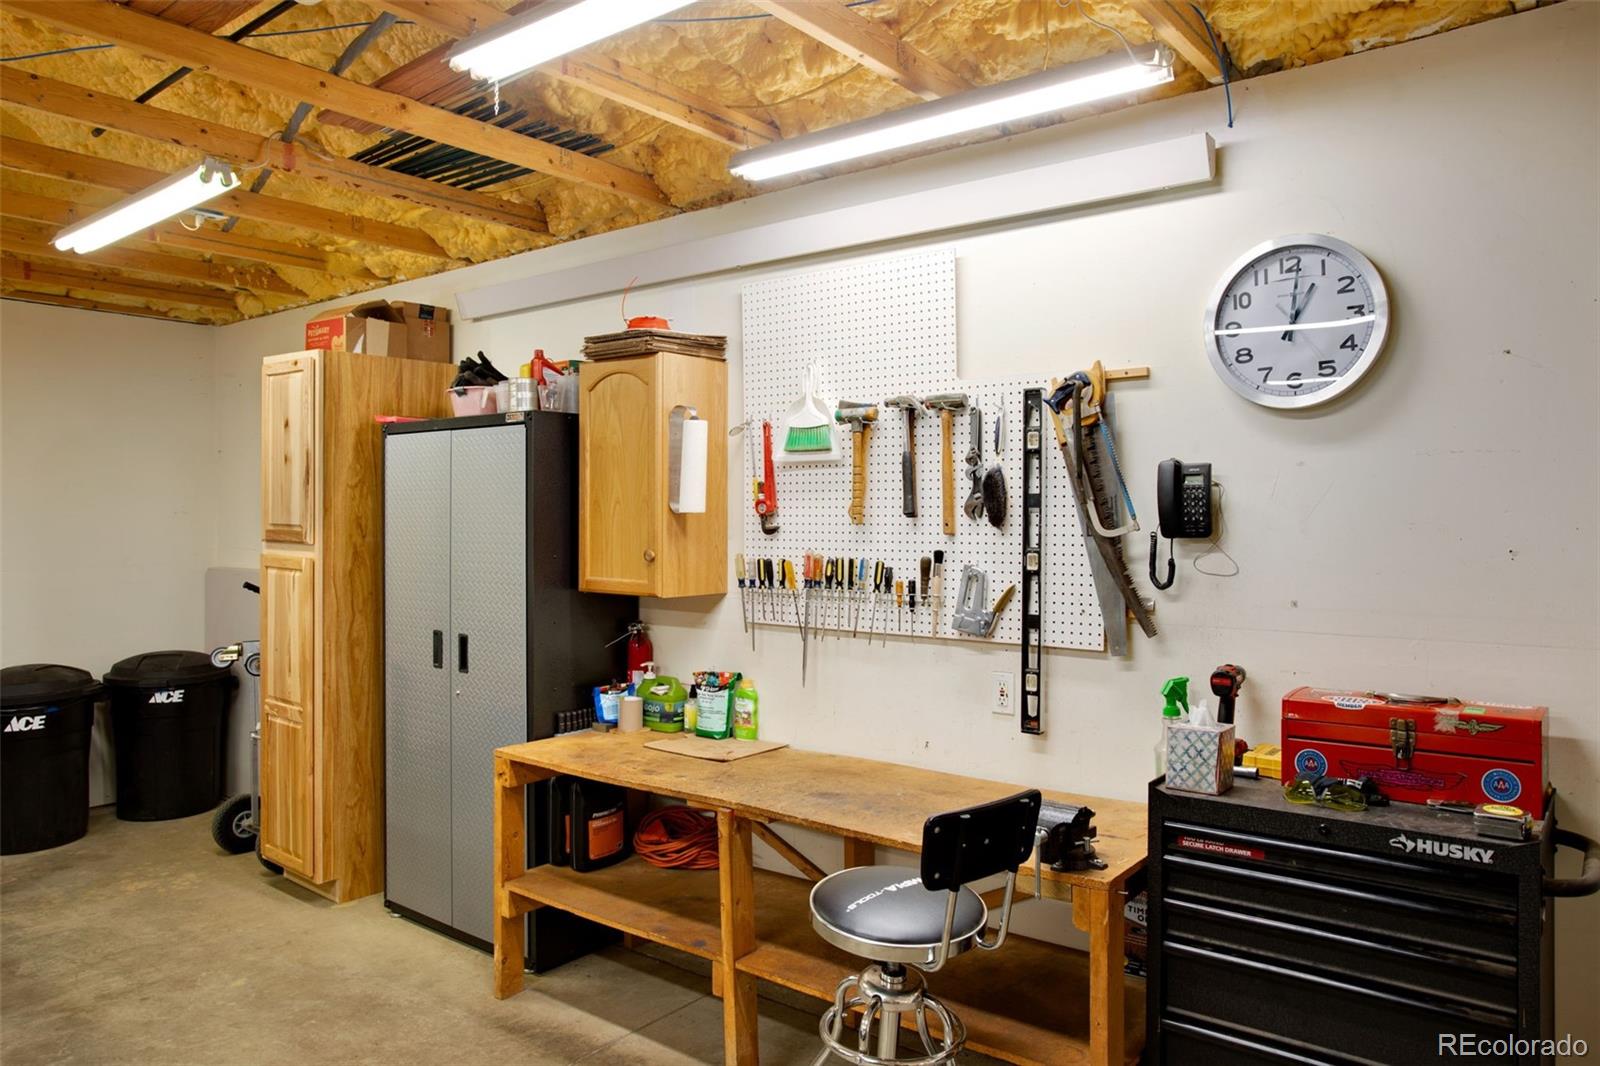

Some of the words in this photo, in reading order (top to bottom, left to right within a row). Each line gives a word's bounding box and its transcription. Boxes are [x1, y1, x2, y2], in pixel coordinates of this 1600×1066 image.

[1279, 256, 1302, 274] 12
[1321, 259, 1327, 276] 1
[1254, 268, 1269, 287] 11
[1337, 275, 1355, 294] 2
[1233, 291, 1252, 310] 10
[1224, 321, 1242, 338] 9
[1339, 334, 1358, 351] 4
[1235, 347, 1253, 364] 8
[1257, 366, 1273, 383] 7
[1318, 360, 1337, 377] 5
[1286, 372, 1303, 389] 6
[149, 689, 185, 704] ACE
[4, 714, 47, 732] ACE
[1182, 839, 1205, 849] SECURE
[1205, 842, 1224, 853] LATCH
[1225, 846, 1252, 857] DRAWER
[1416, 838, 1495, 864] HUSKY
